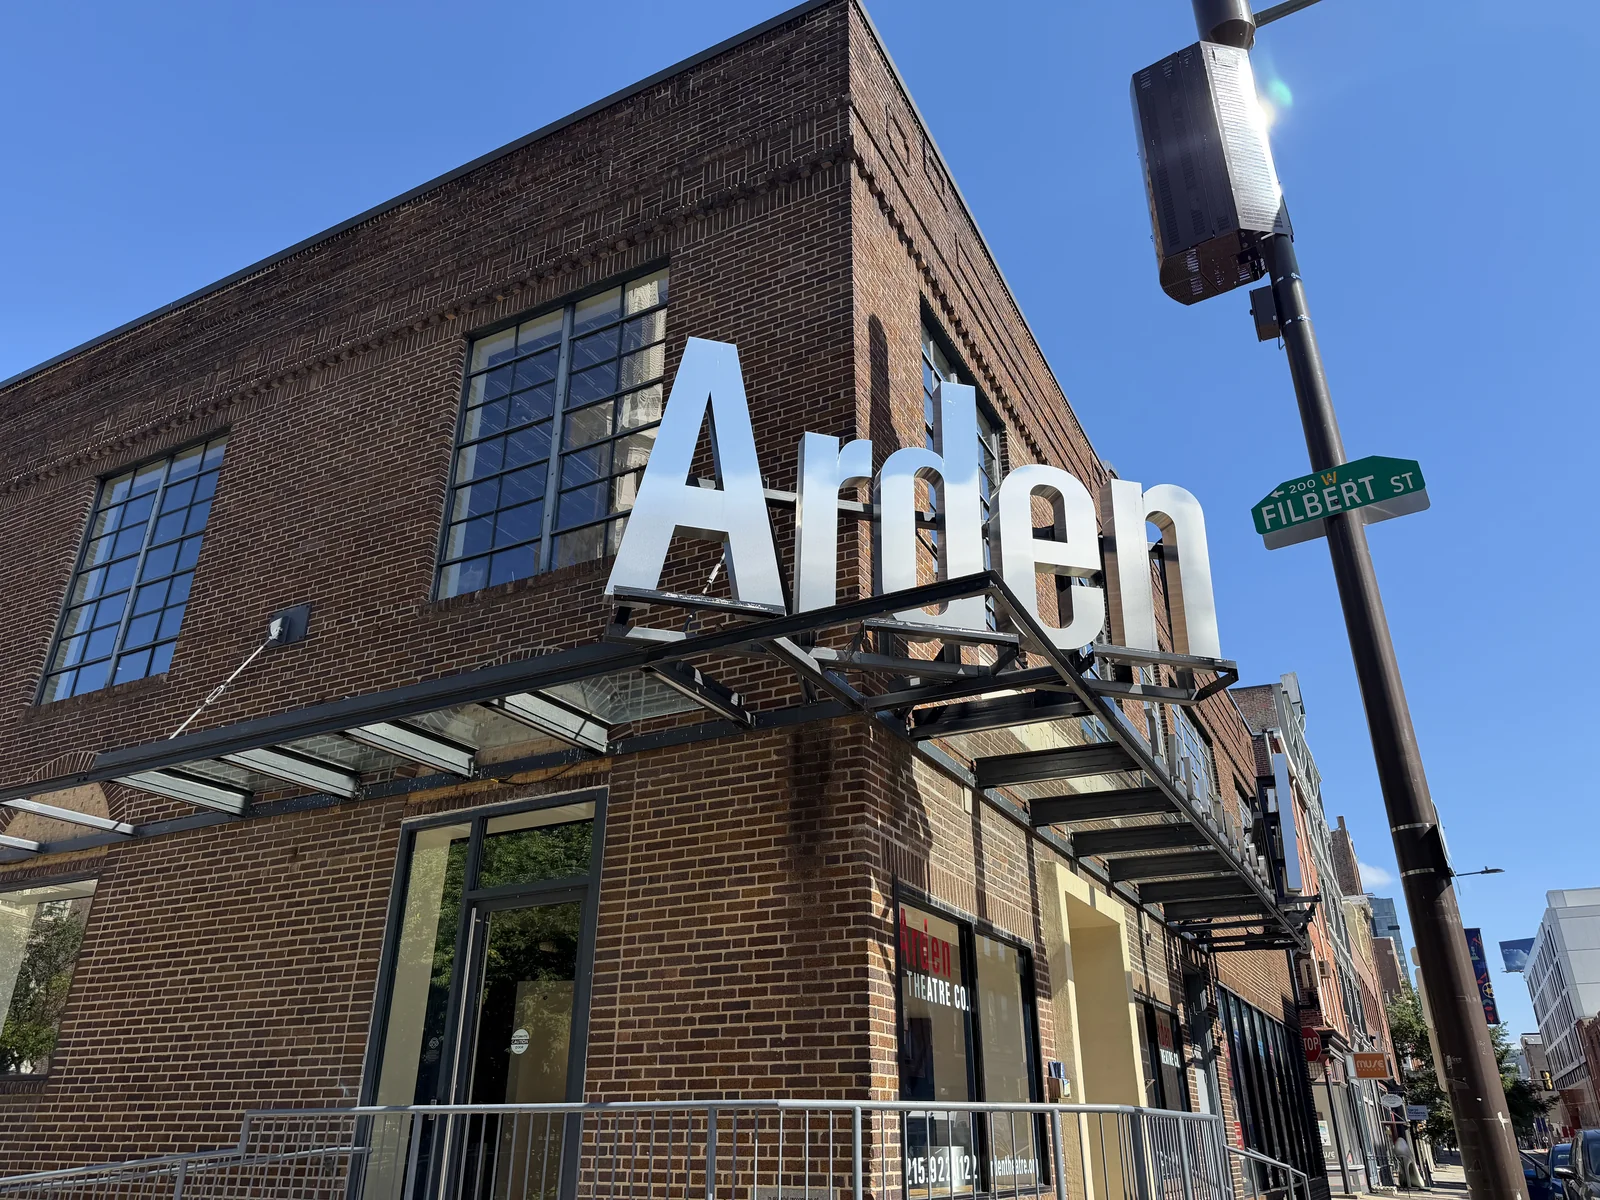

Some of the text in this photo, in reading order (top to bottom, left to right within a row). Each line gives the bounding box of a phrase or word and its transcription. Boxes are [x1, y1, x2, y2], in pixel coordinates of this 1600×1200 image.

[604, 336, 1221, 658] Arden
[1288, 471, 1337, 494] 200 W
[1261, 472, 1414, 530] FILBERT ST
[900, 908, 951, 978] Arden
[907, 971, 970, 1011] THEATRE CO.
[1303, 1037, 1319, 1051] TOP
[907, 1155, 978, 1185] 215.9221122
[1323, 1151, 1336, 1159] USE
